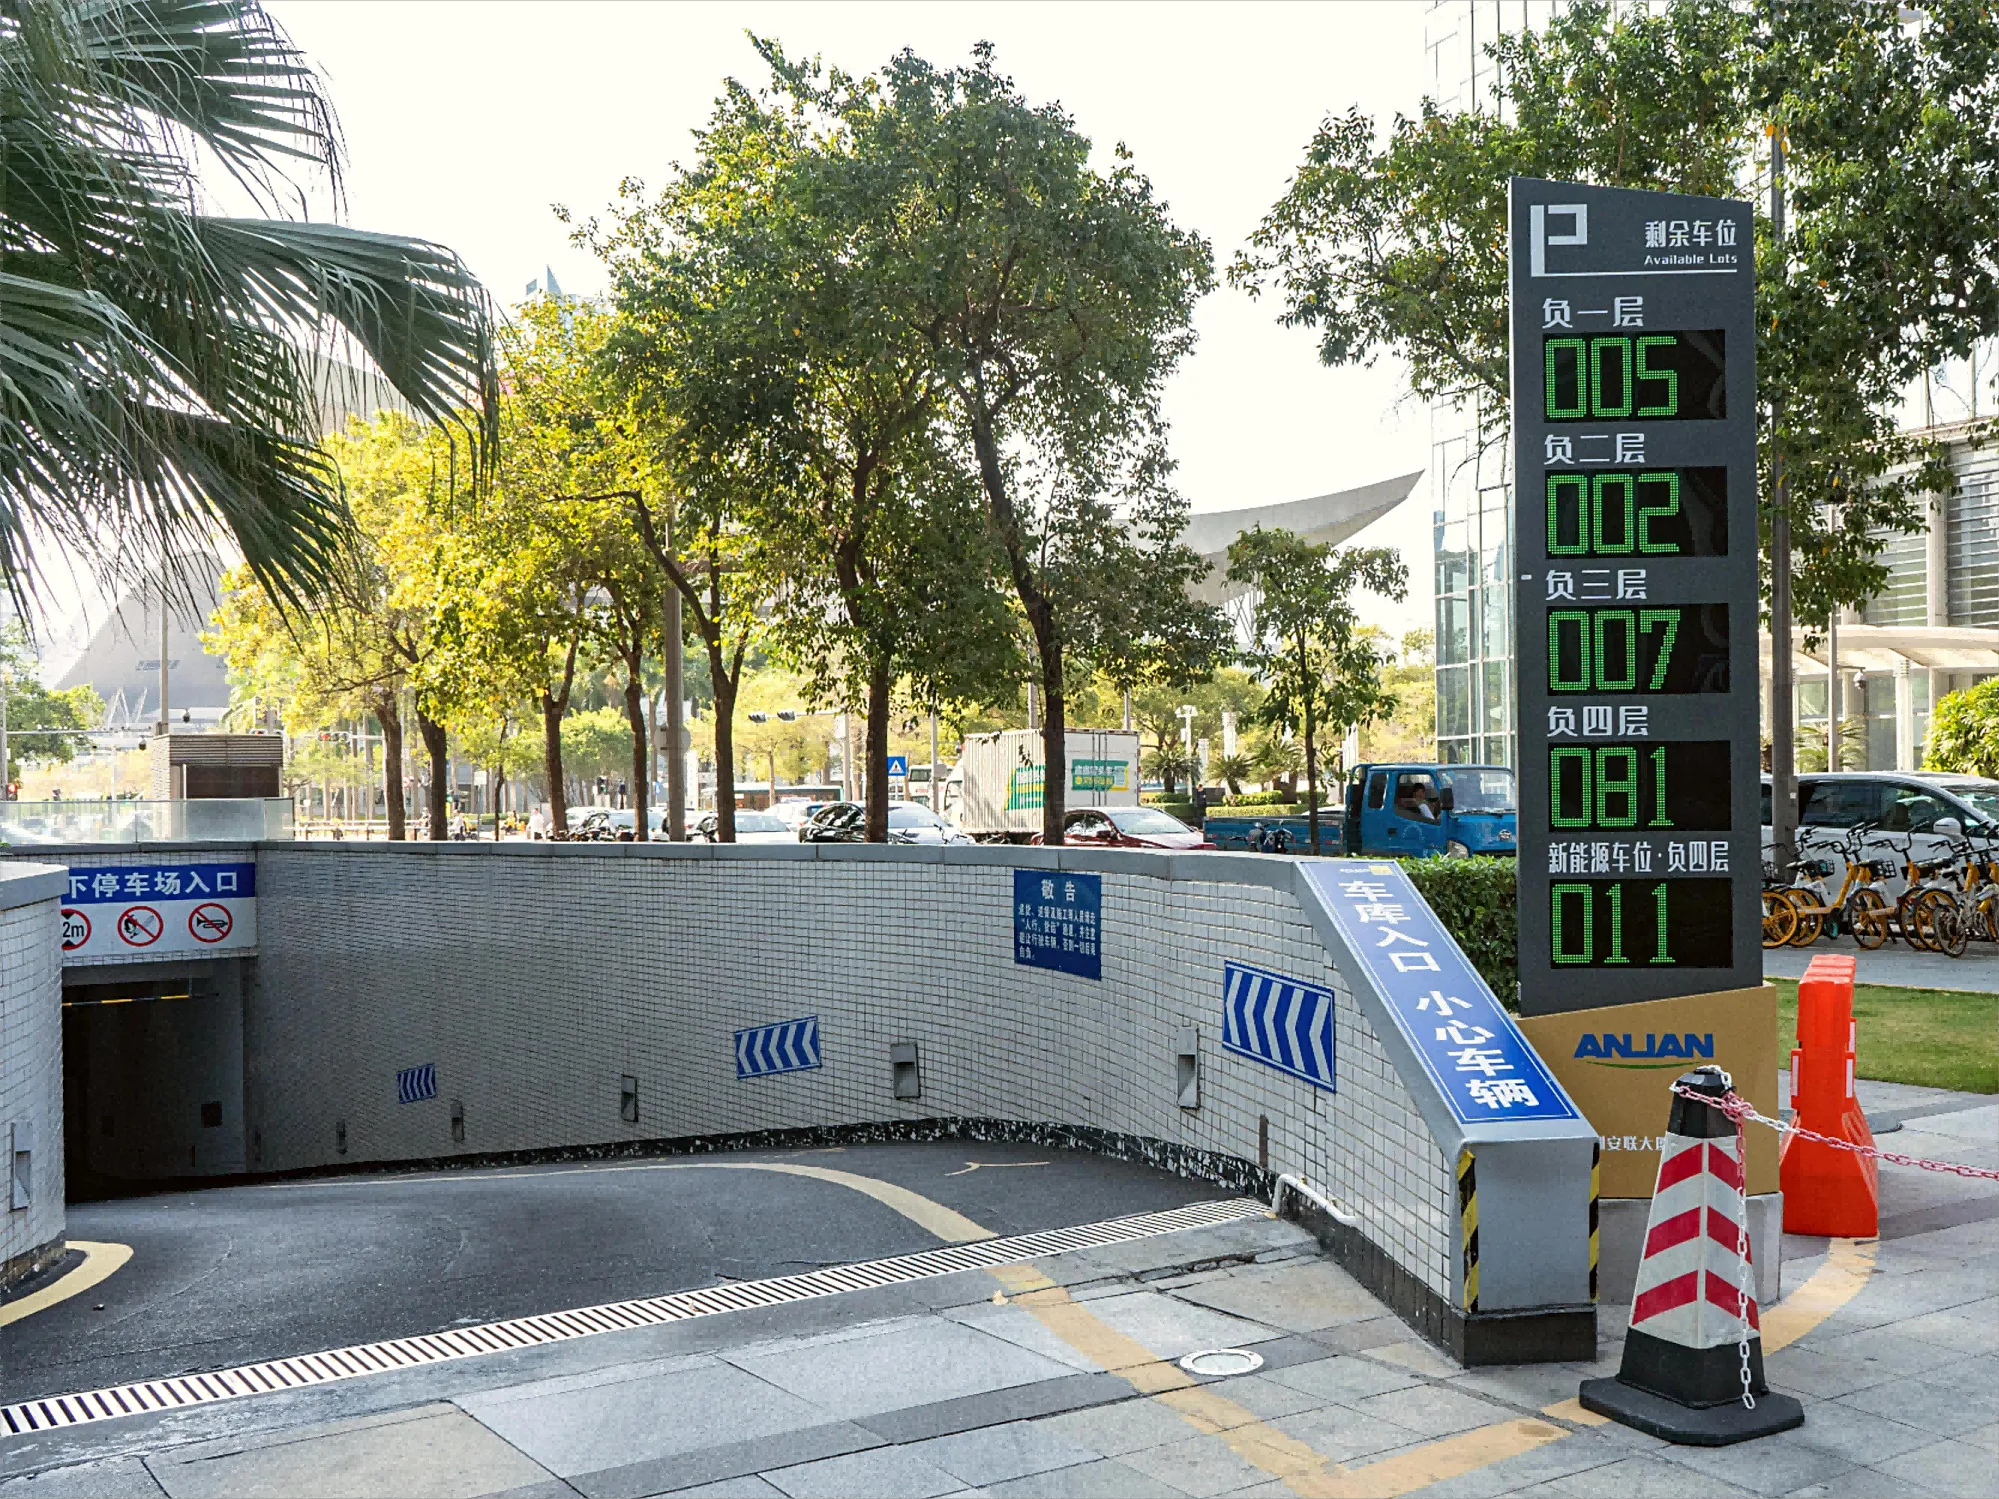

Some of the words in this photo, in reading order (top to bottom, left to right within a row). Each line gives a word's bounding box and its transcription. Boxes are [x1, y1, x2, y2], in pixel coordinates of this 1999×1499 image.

[1645, 219, 1738, 249] 剩余车位
[1644, 254, 1704, 265] Available
[1709, 253, 1738, 264] Lots
[1542, 296, 1644, 329] 负一层
[1545, 336, 1679, 419] 005
[1544, 433, 1646, 465] 负二层
[1547, 472, 1680, 555] 002
[1545, 569, 1647, 600] 负三层
[1549, 609, 1681, 692] 007
[1547, 705, 1649, 737] 负四层
[1551, 746, 1675, 828] 081
[68, 871, 238, 899] 下停车场入口
[1552, 883, 1676, 964] 011
[1338, 880, 1442, 973] 车库入口
[1416, 990, 1540, 1110] 小心车辆
